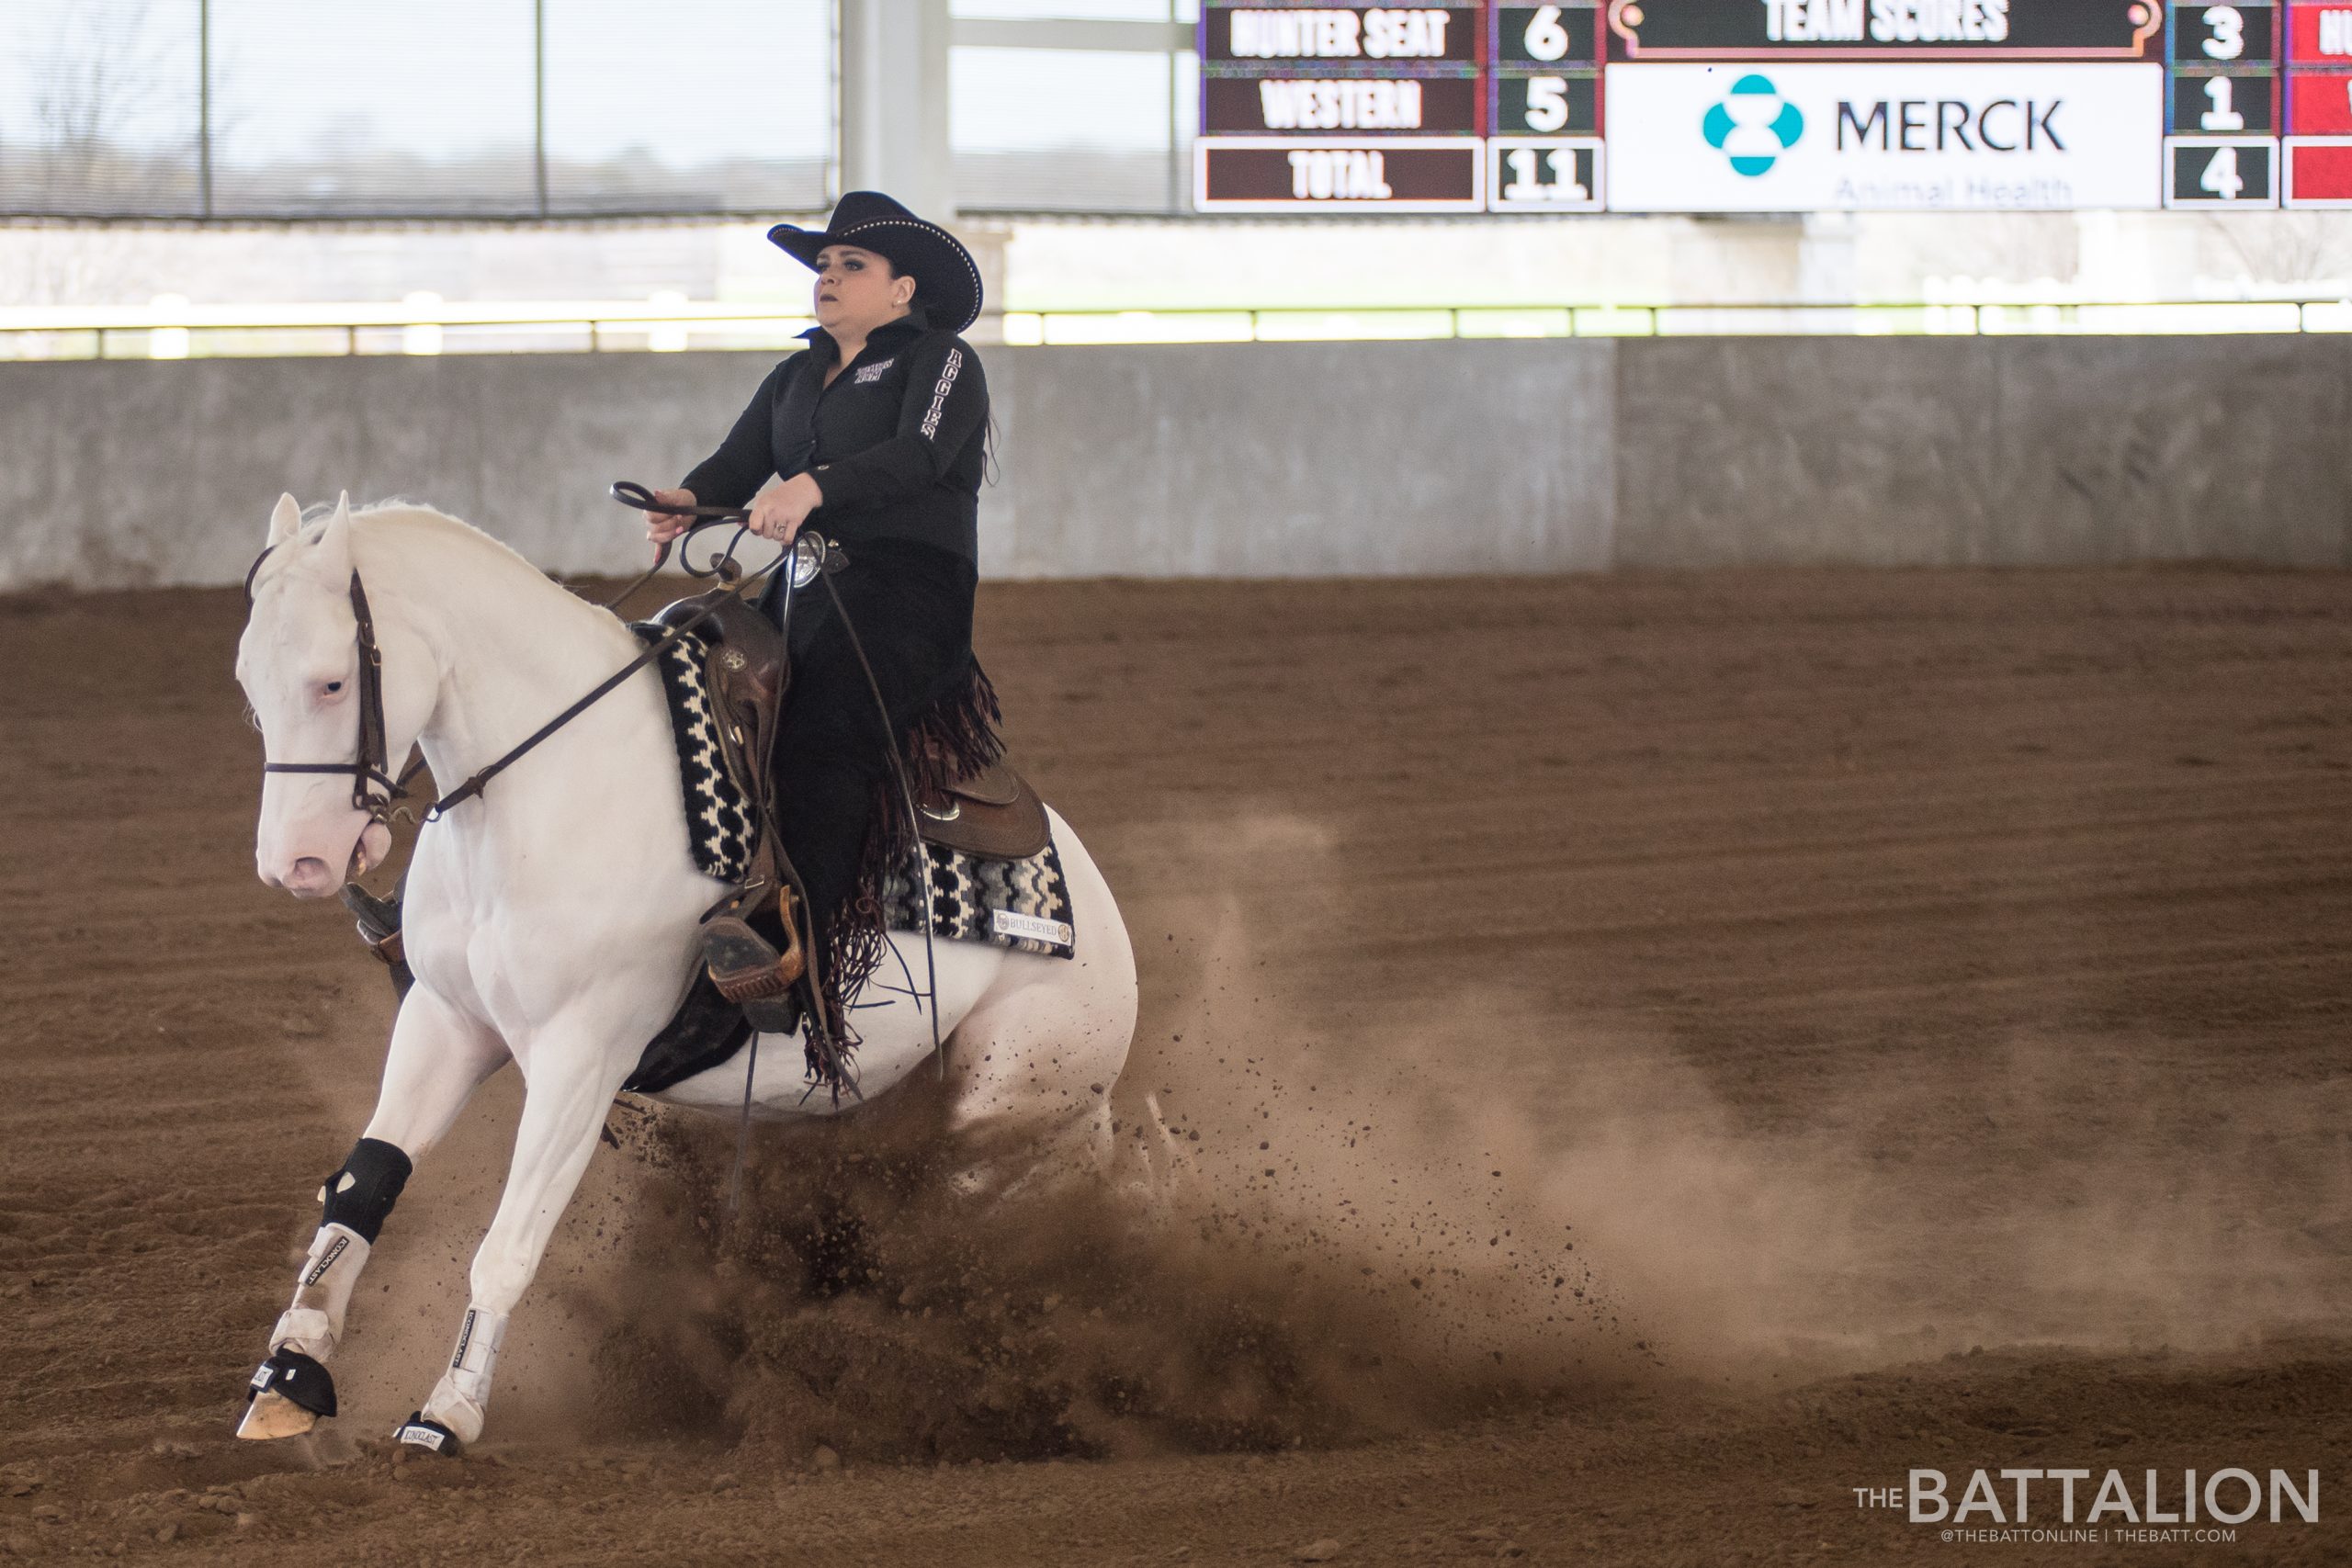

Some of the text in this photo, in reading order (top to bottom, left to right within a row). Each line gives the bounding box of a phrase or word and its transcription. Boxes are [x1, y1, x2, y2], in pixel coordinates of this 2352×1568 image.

[1230, 8, 1451, 58] HUNTER SEAT
[1524, 5, 1568, 62] 6
[1761, 0, 2009, 42] TEAM SCORES
[2201, 6, 2245, 60] 3
[1260, 80, 1422, 130] WESTERN
[1524, 76, 1568, 132] 5
[1837, 99, 2066, 152] MERCK
[2200, 75, 2244, 130] 1
[1288, 149, 1392, 199] TOTAL
[1504, 149, 1588, 200] 11
[1837, 175, 2074, 208] Animal Health
[2200, 147, 2244, 200] 4
[921, 348, 963, 441] AGGIES
[1010, 919, 1057, 936] BULLSEYED
[309, 1237, 348, 1285] ICONOCLAST
